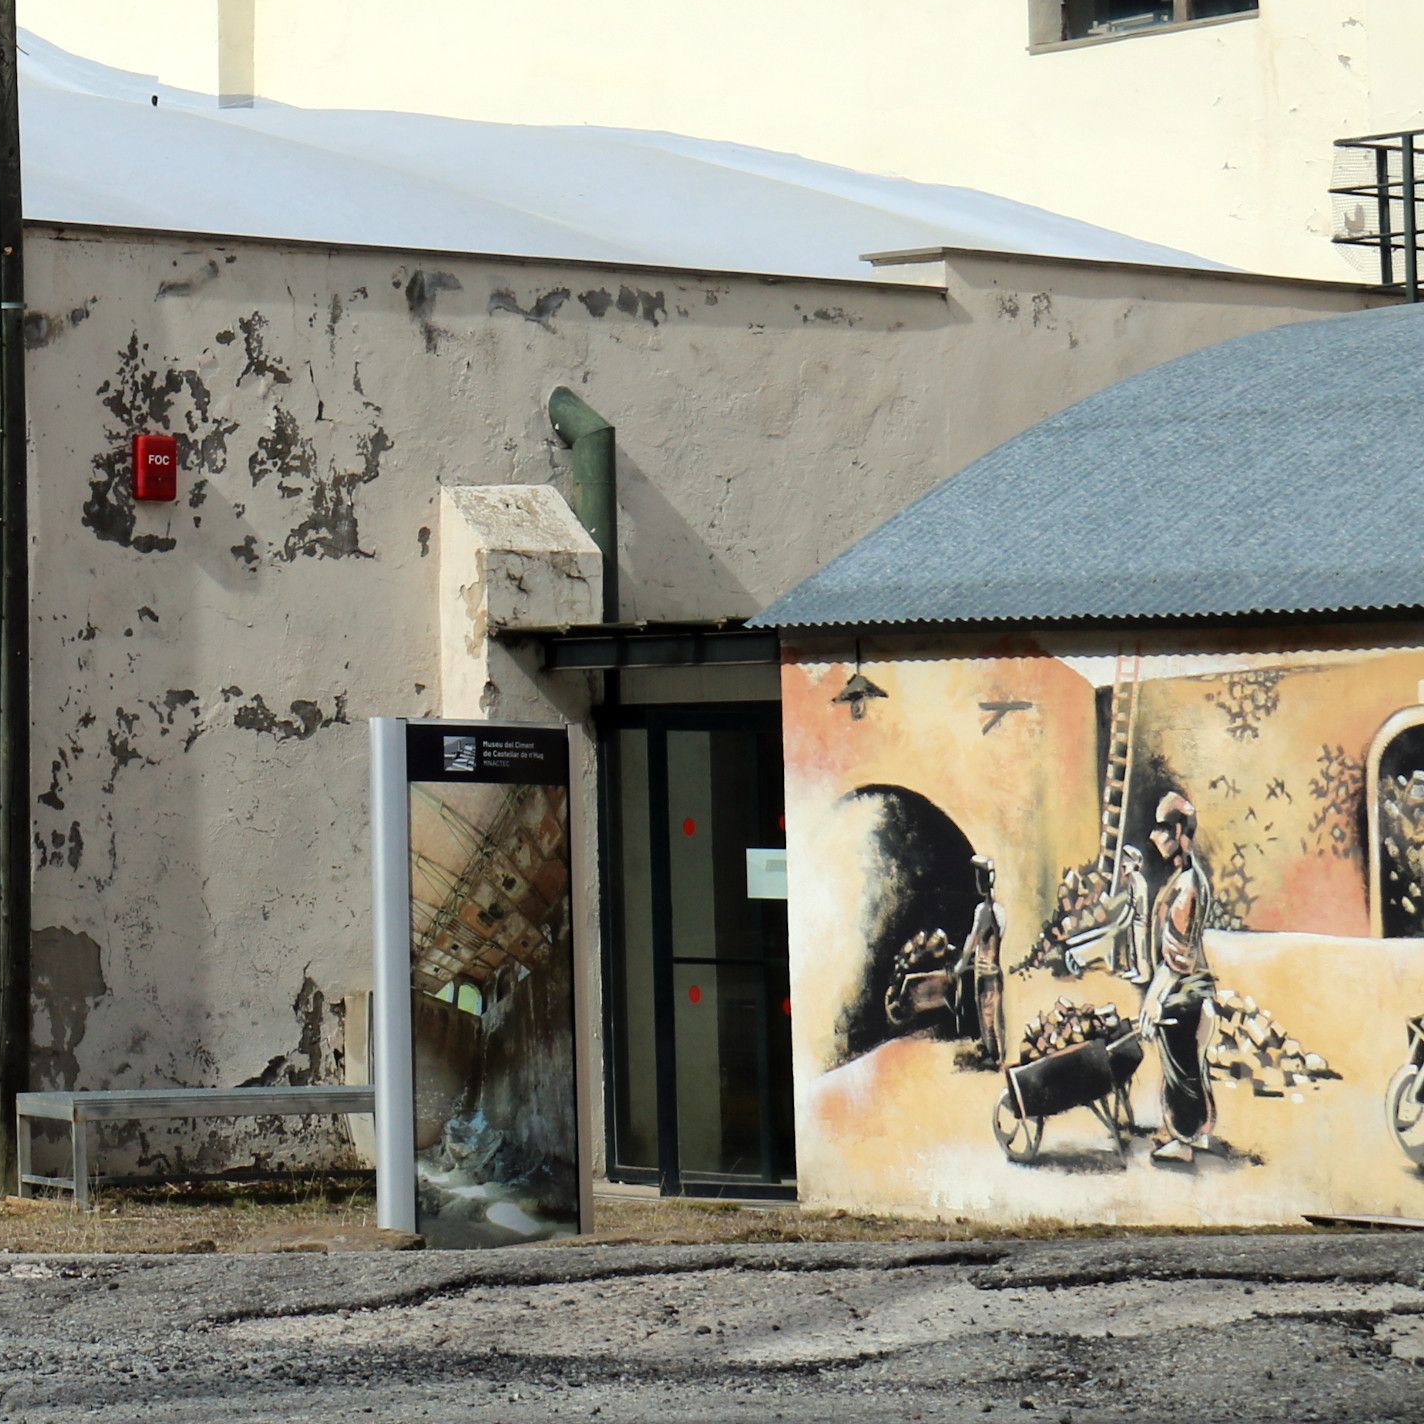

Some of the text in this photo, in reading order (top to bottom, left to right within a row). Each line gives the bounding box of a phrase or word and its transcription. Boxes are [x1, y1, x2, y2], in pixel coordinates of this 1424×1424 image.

[148, 454, 170, 466] FOC
[504, 740, 514, 748] del
[515, 741, 534, 749] Ciment
[483, 750, 492, 758] de
[493, 750, 519, 758] Castellar
